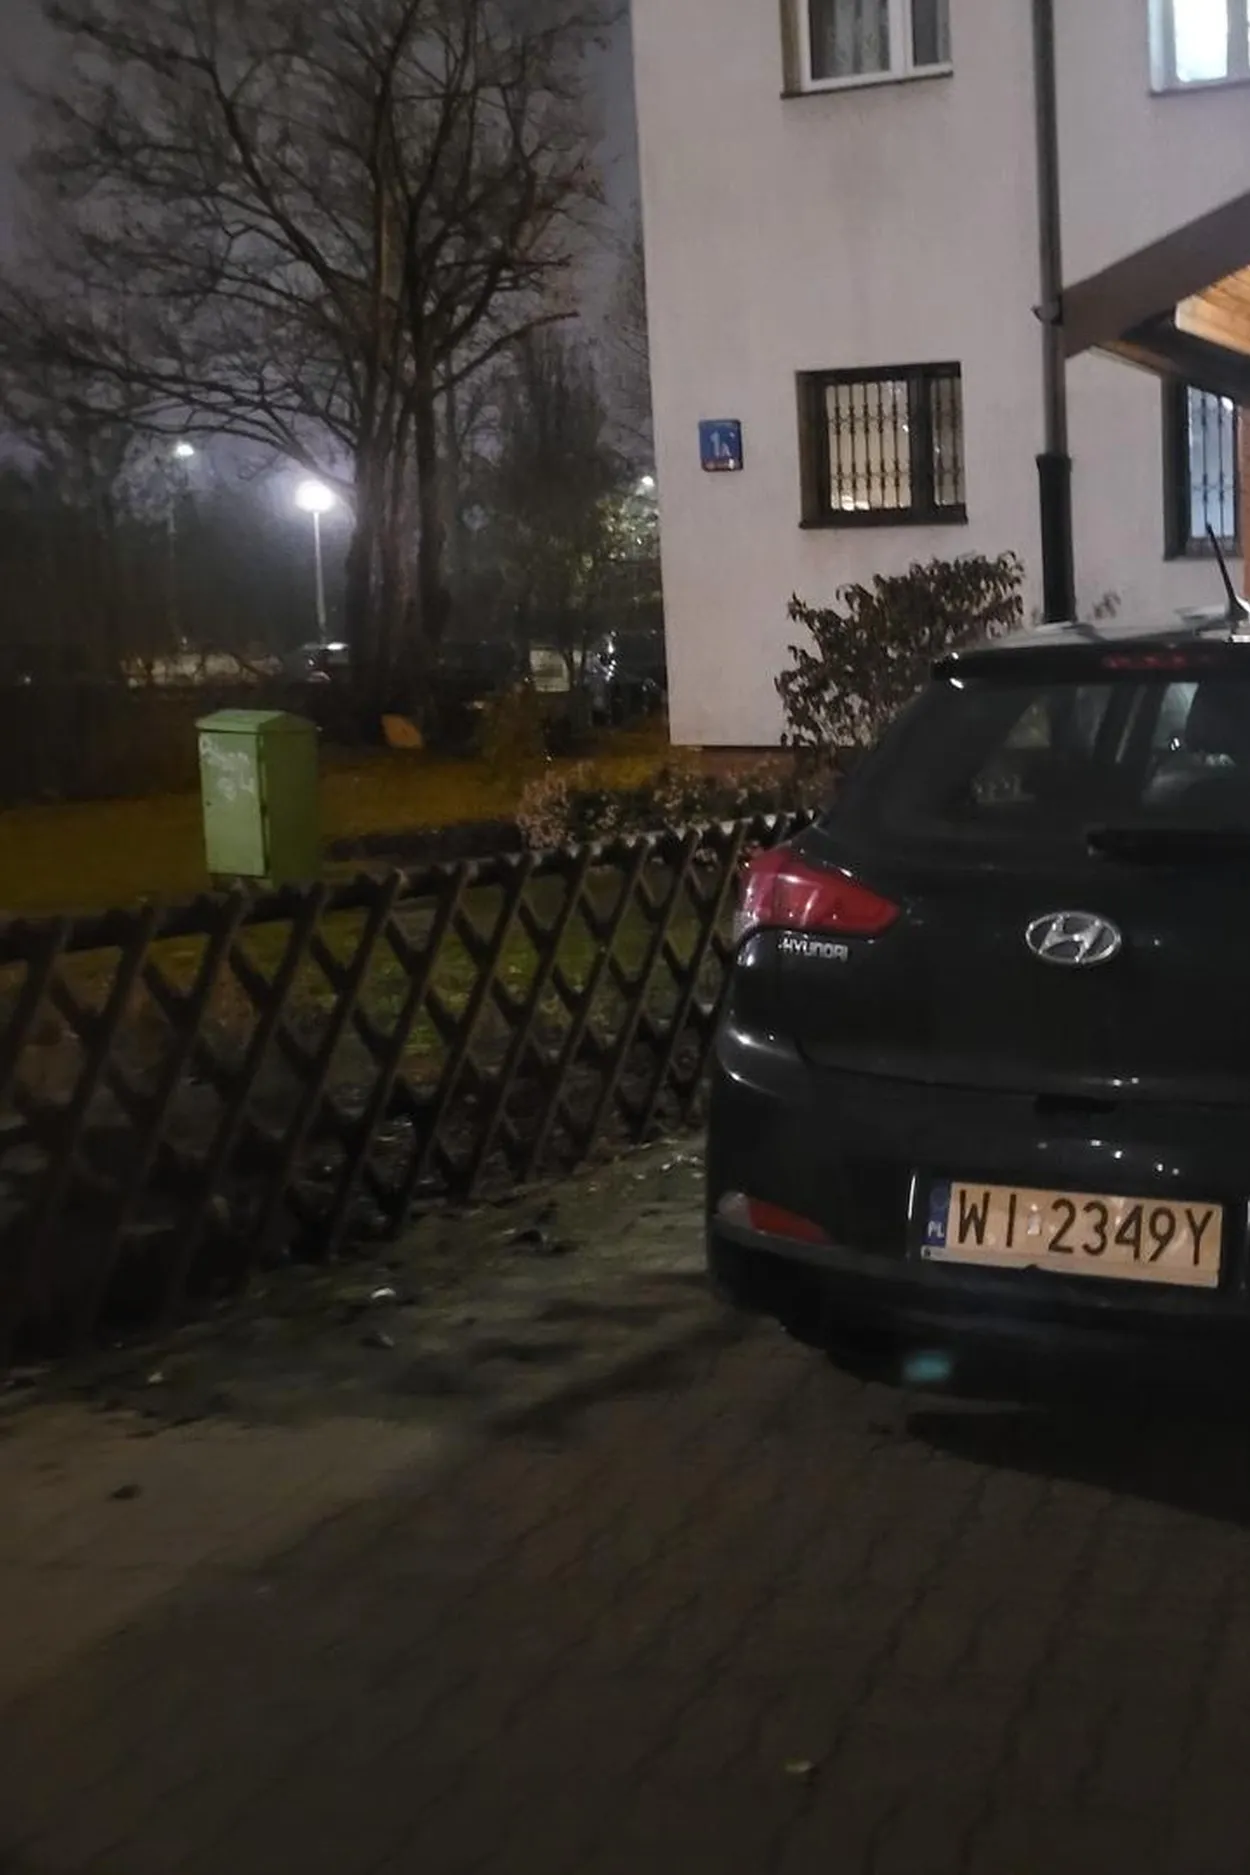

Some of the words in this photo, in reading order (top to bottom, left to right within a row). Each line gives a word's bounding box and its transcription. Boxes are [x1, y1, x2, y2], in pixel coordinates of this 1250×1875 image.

[781, 936, 849, 962] HYUNDAI
[928, 1220, 945, 1238] PL
[957, 1189, 1017, 1248] WI
[1047, 1197, 1213, 1266] 2349Y
